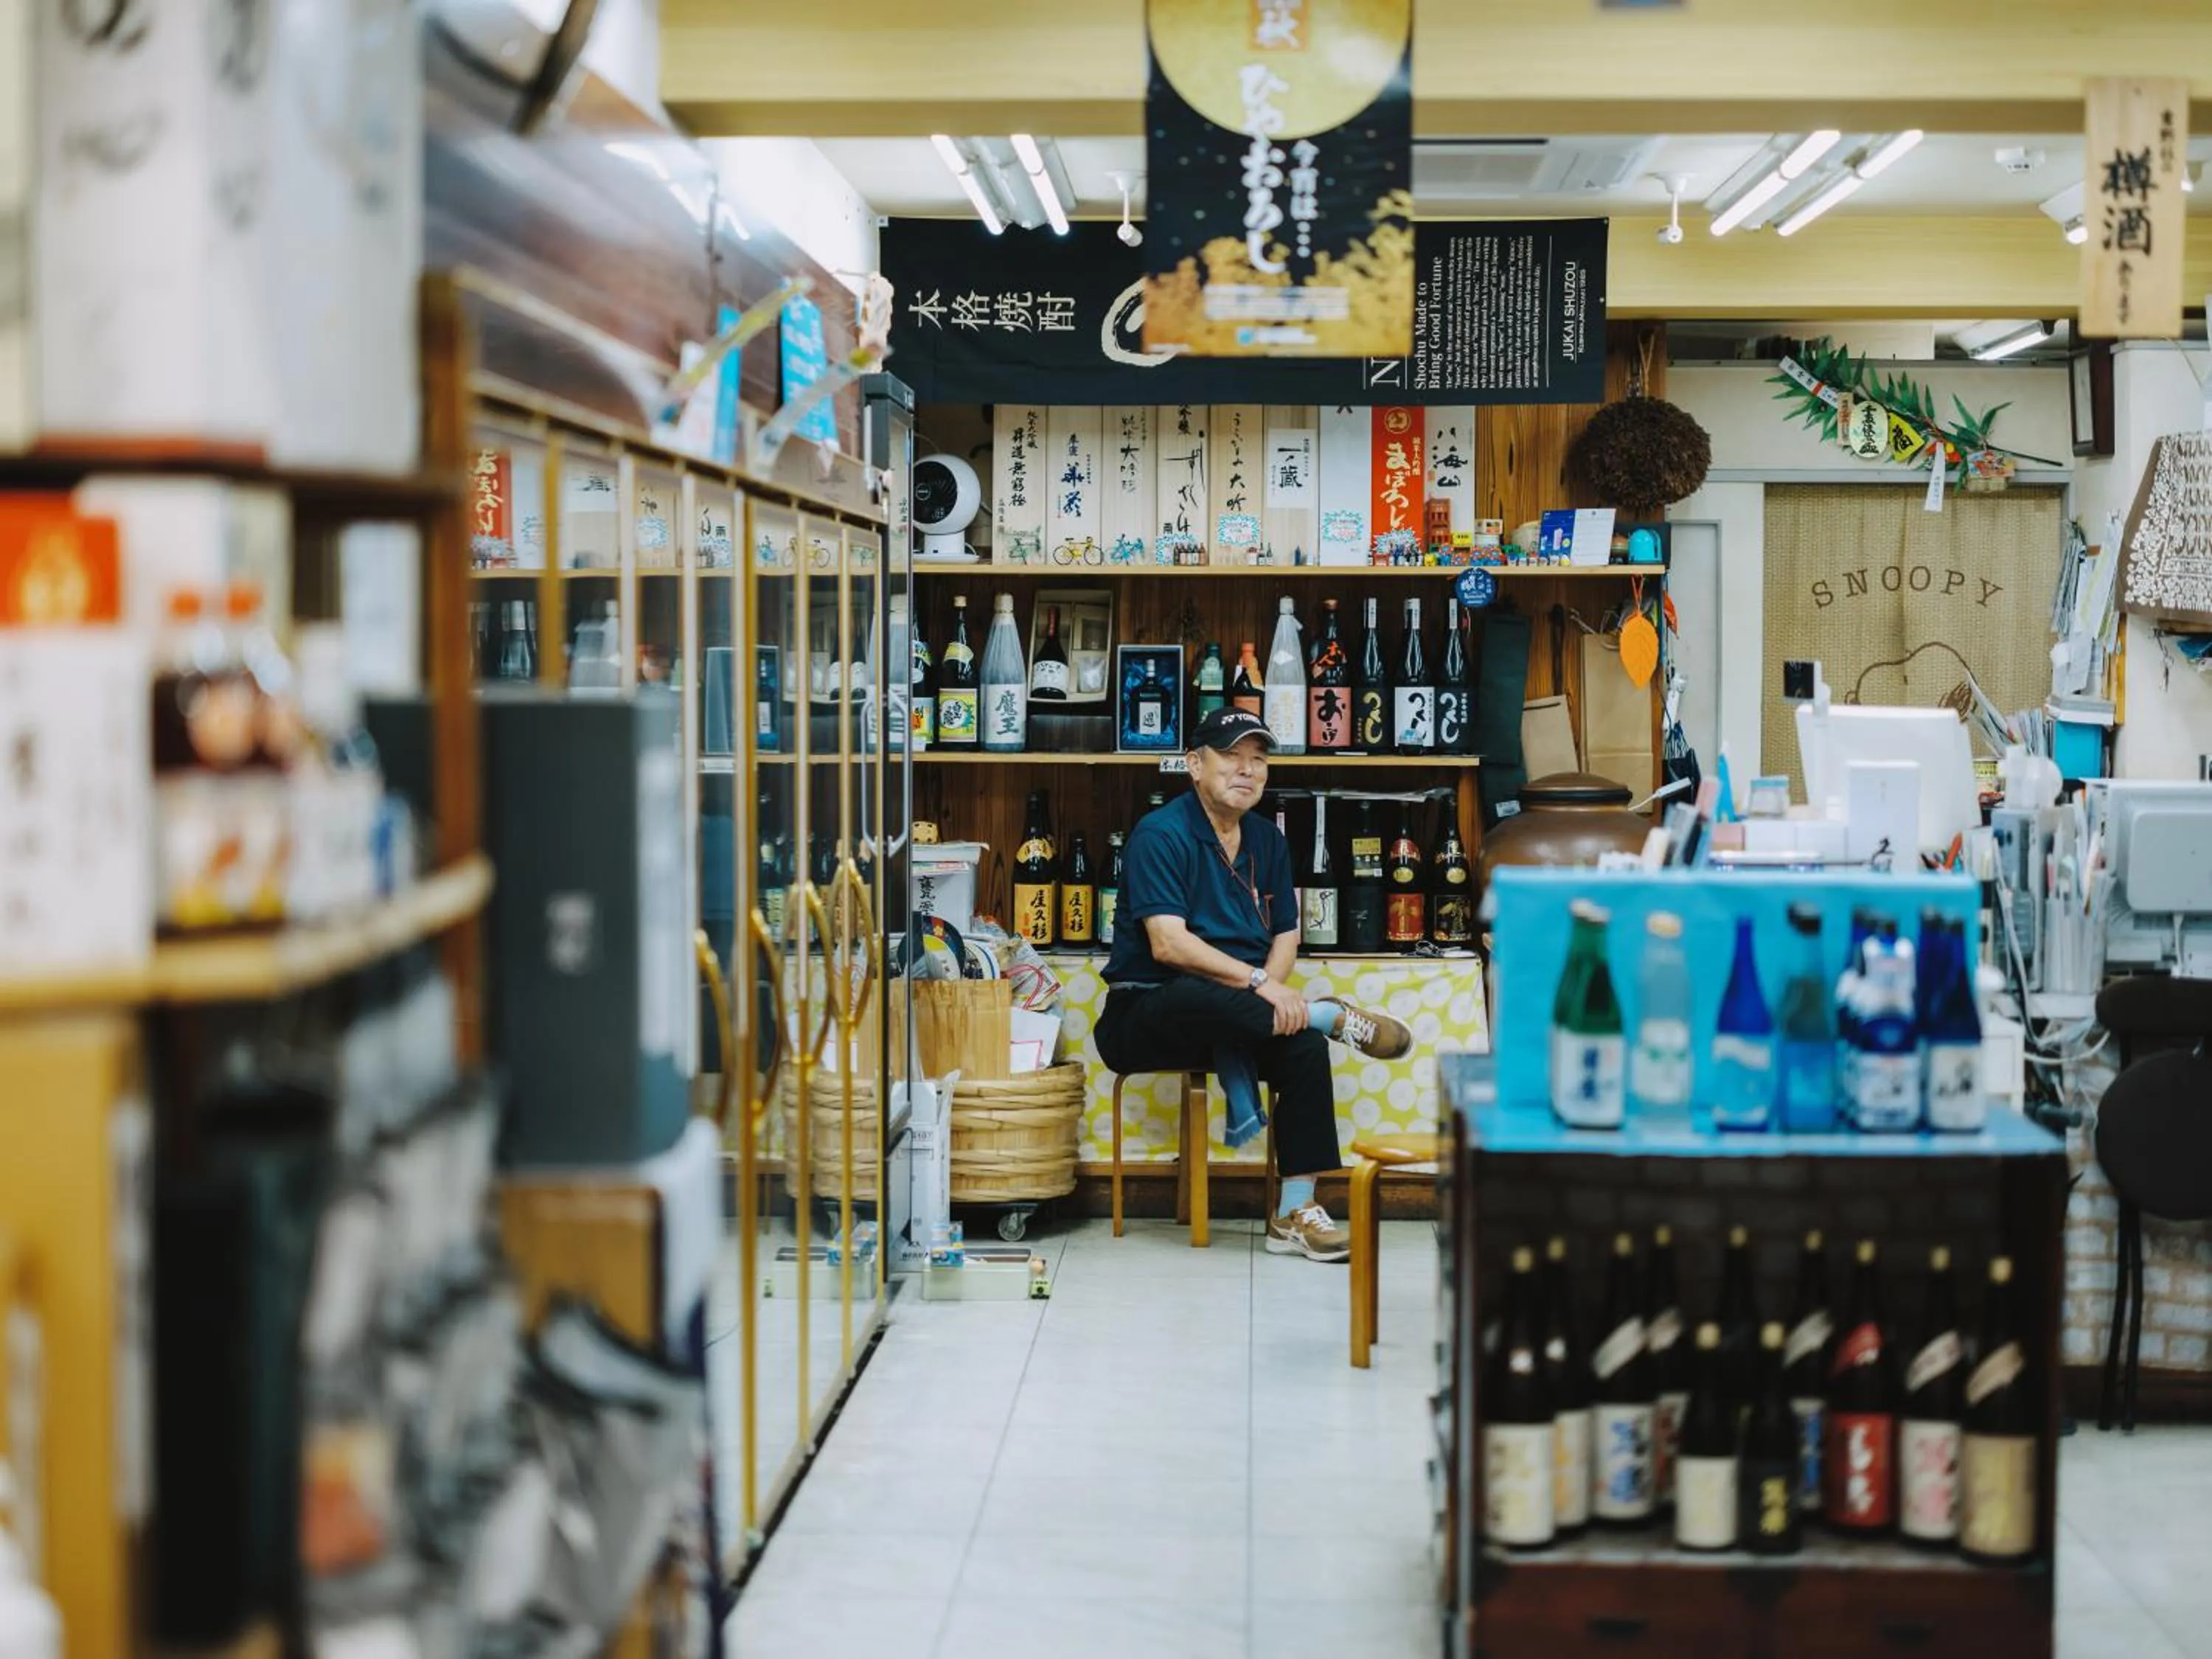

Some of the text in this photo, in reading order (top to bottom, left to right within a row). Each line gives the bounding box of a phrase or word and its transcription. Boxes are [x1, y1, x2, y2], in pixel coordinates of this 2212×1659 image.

[908, 288, 1076, 333] 本格焼酎
[1414, 282, 1427, 389] Shochu Made to
[1428, 257, 1444, 388] Bring Good Fortune
[1562, 261, 1576, 360] JUKAI SHUZOU
[1277, 448, 1303, 488] 一ノ蔵
[1432, 427, 1468, 487] 八海山
[1380, 442, 1411, 529] まぼろし
[1811, 565, 2004, 609] SNOOPY
[995, 689, 1019, 735] 魔王
[1439, 692, 1459, 744] つくし
[1030, 889, 1048, 940] 屋久杉
[1069, 891, 1084, 933] 屋久杉
